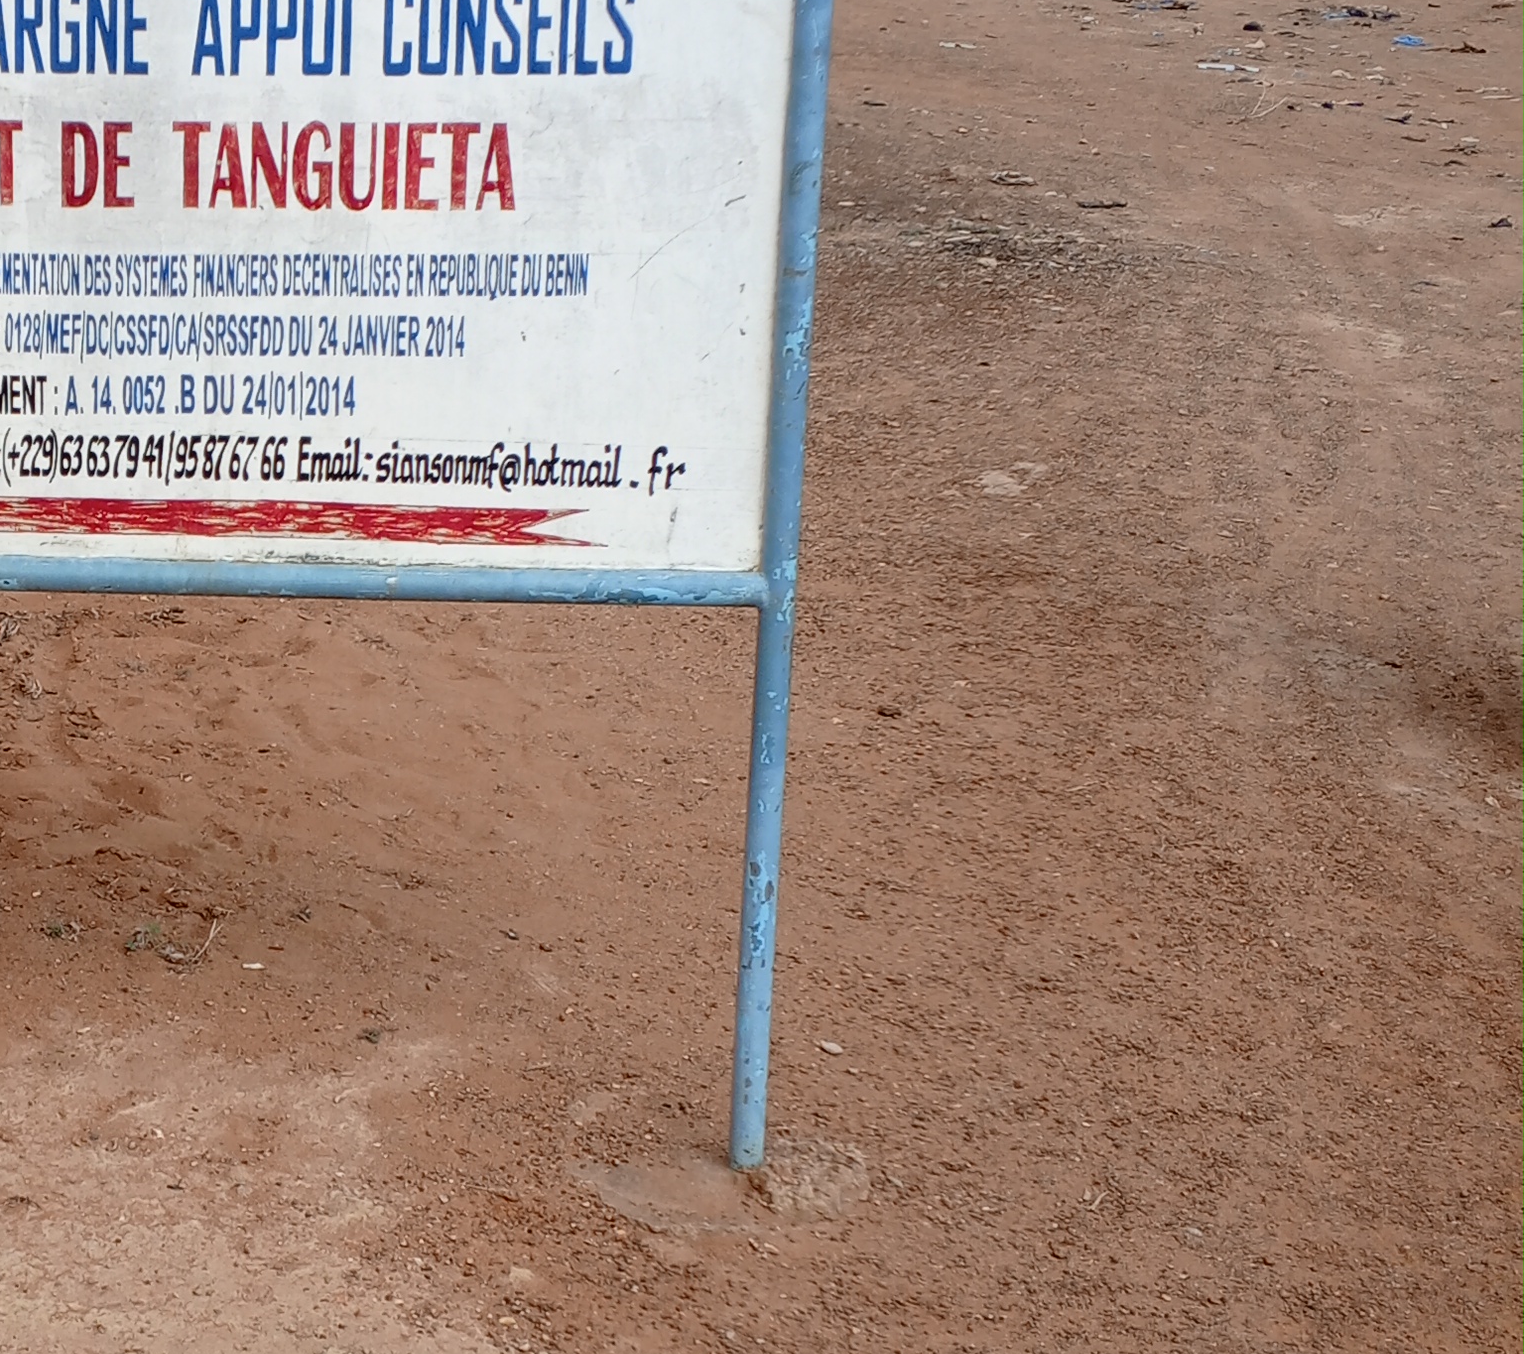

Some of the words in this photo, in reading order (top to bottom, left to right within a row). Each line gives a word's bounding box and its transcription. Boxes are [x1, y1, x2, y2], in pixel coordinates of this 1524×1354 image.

[60, 120, 135, 209] DE
[172, 120, 516, 212] TANGUIETA
[84, 254, 112, 297] DES
[115, 254, 188, 297] SYSTEMES
[193, 254, 279, 298] FINANCIERS
[282, 253, 403, 298] DECENTRALISES
[406, 253, 425, 297] EN
[428, 253, 519, 301] REPUBLIQUE
[520, 253, 543, 297] DU
[544, 253, 590, 297] BENIN
[288, 315, 313, 357] DU
[318, 315, 339, 356] 24
[342, 314, 421, 357] JANVIER
[424, 315, 465, 358] 2014
[122, 375, 166, 415] 0052
[203, 375, 235, 416] DU
[241, 371, 356, 421] 24/01/2014
